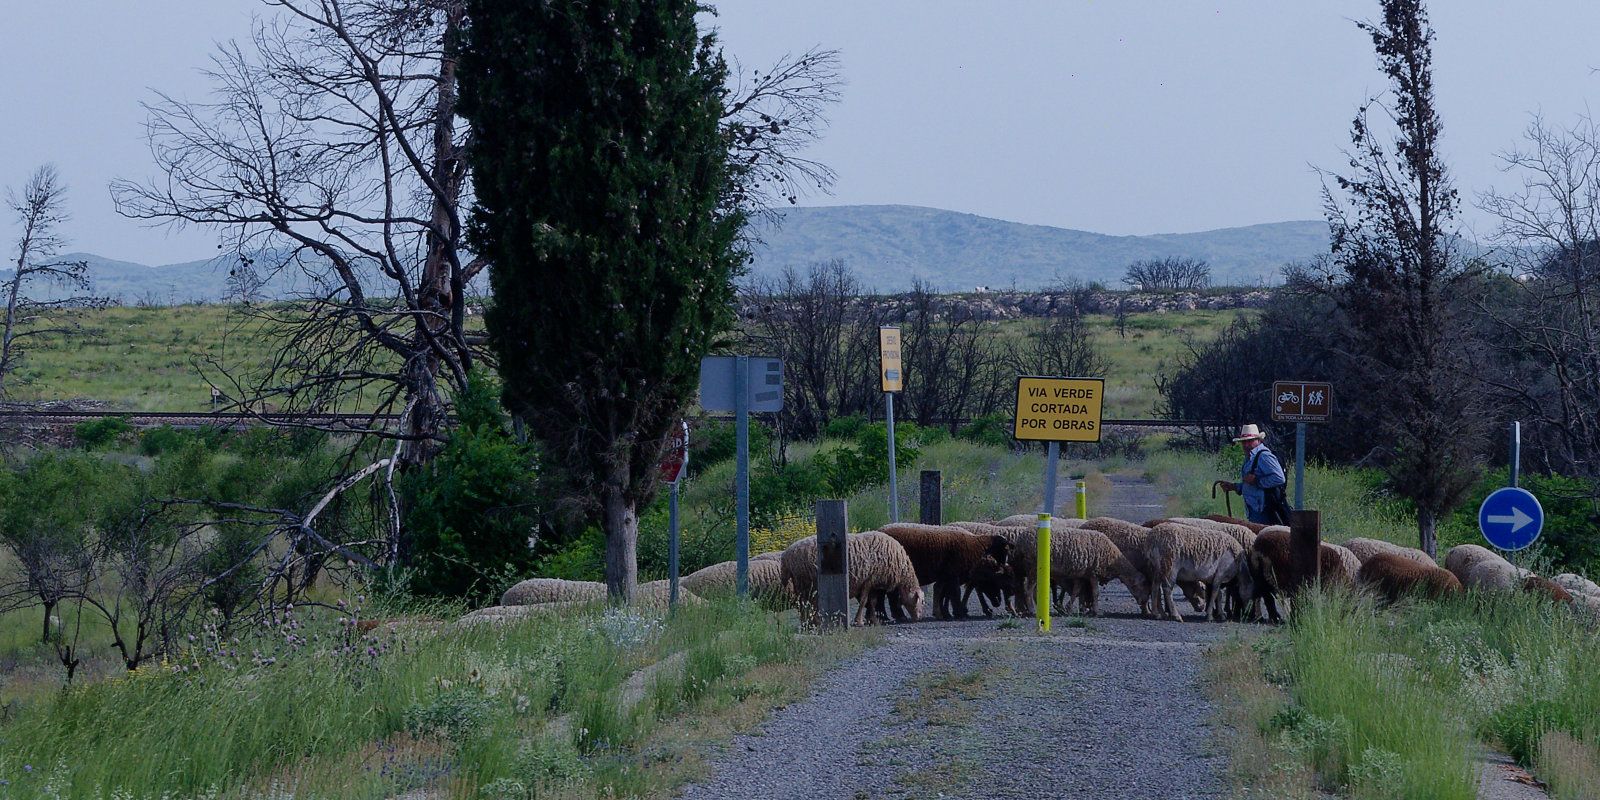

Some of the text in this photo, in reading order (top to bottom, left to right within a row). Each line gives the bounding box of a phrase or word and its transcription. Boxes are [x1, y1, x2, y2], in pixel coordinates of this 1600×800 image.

[1028, 387, 1094, 399] VIA VERDE
[1031, 403, 1088, 414] CORTADA
[1021, 418, 1095, 430] POR OBRAS
